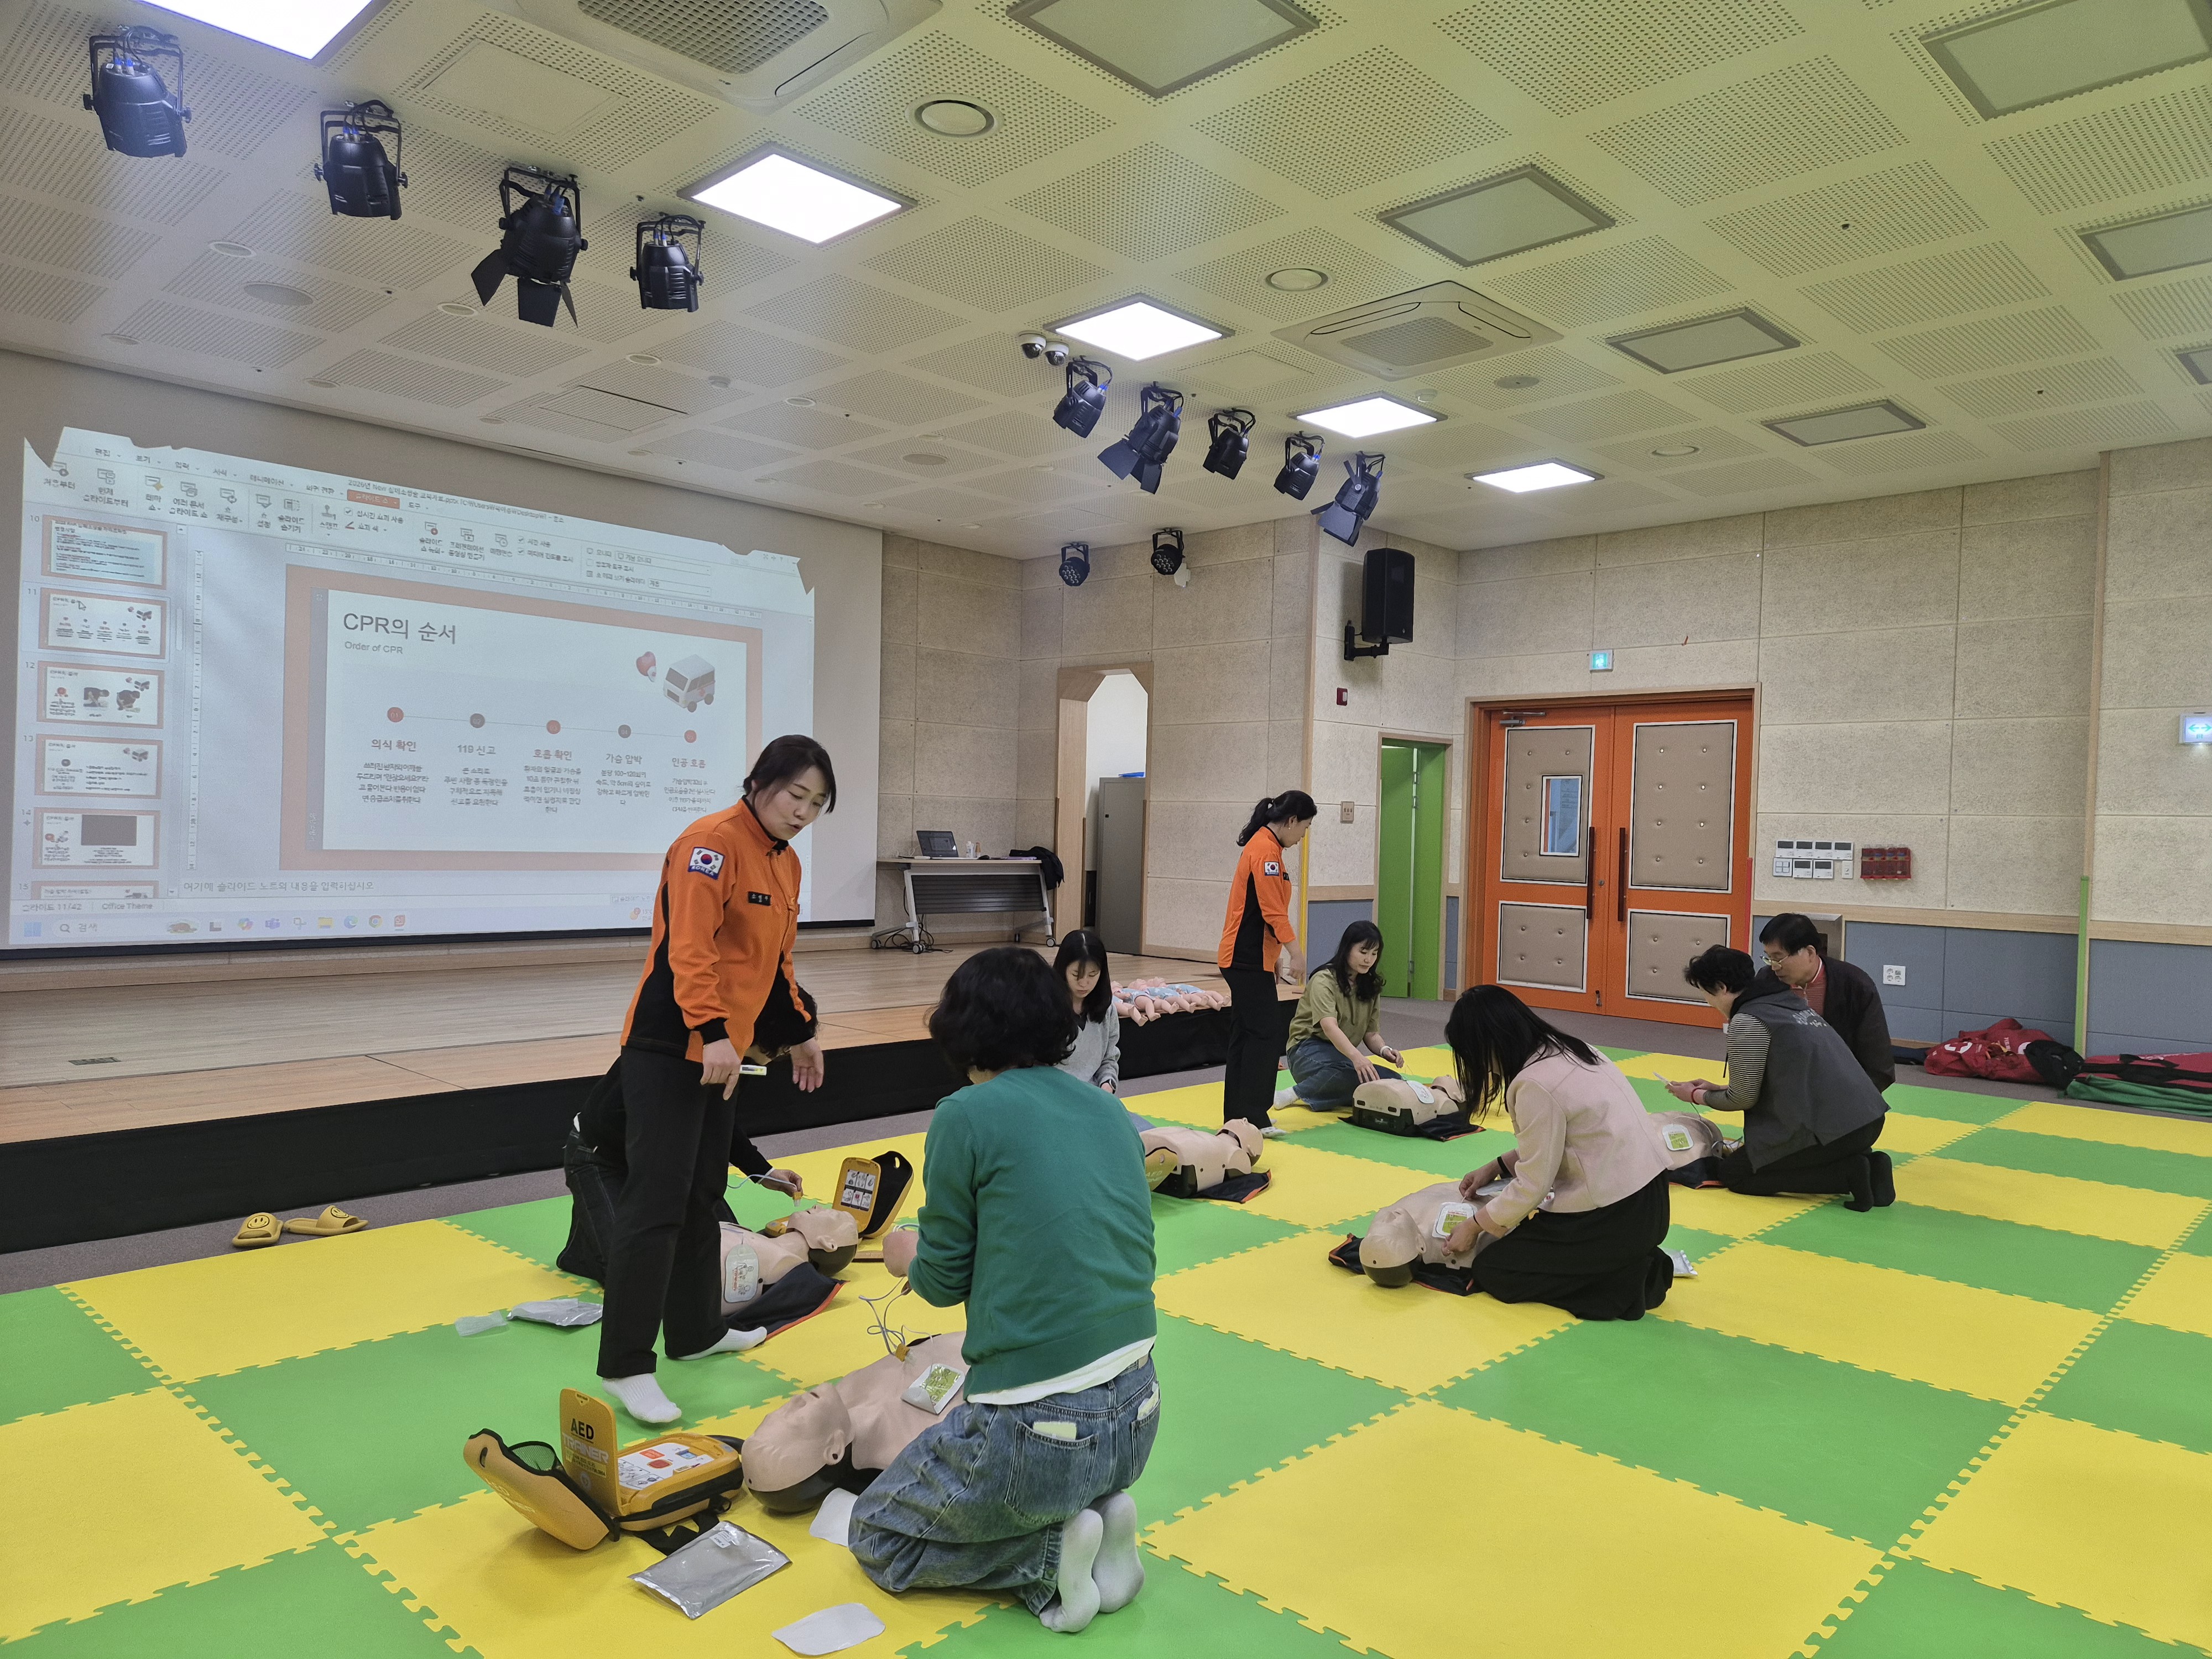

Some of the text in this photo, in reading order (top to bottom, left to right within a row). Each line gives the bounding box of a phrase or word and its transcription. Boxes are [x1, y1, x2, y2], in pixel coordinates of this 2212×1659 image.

[173, 497, 205, 509] 여러 문서
[408, 501, 421, 510] 도구
[343, 612, 456, 644] CPR의 순서
[345, 640, 403, 654] Order of CPR
[371, 739, 416, 752] 의식 확인
[457, 744, 496, 756] 119 신고
[533, 749, 572, 761] 호흡 확인
[606, 753, 643, 765] 가슴 압박
[672, 758, 706, 769] 인공 호흡
[184, 881, 374, 892] 여기에 슬라이드 노트의 내용을 입력하십시오
[79, 922, 98, 933] 검색
[571, 1418, 594, 1440] AED
[561, 1431, 609, 1464] TRAINER
